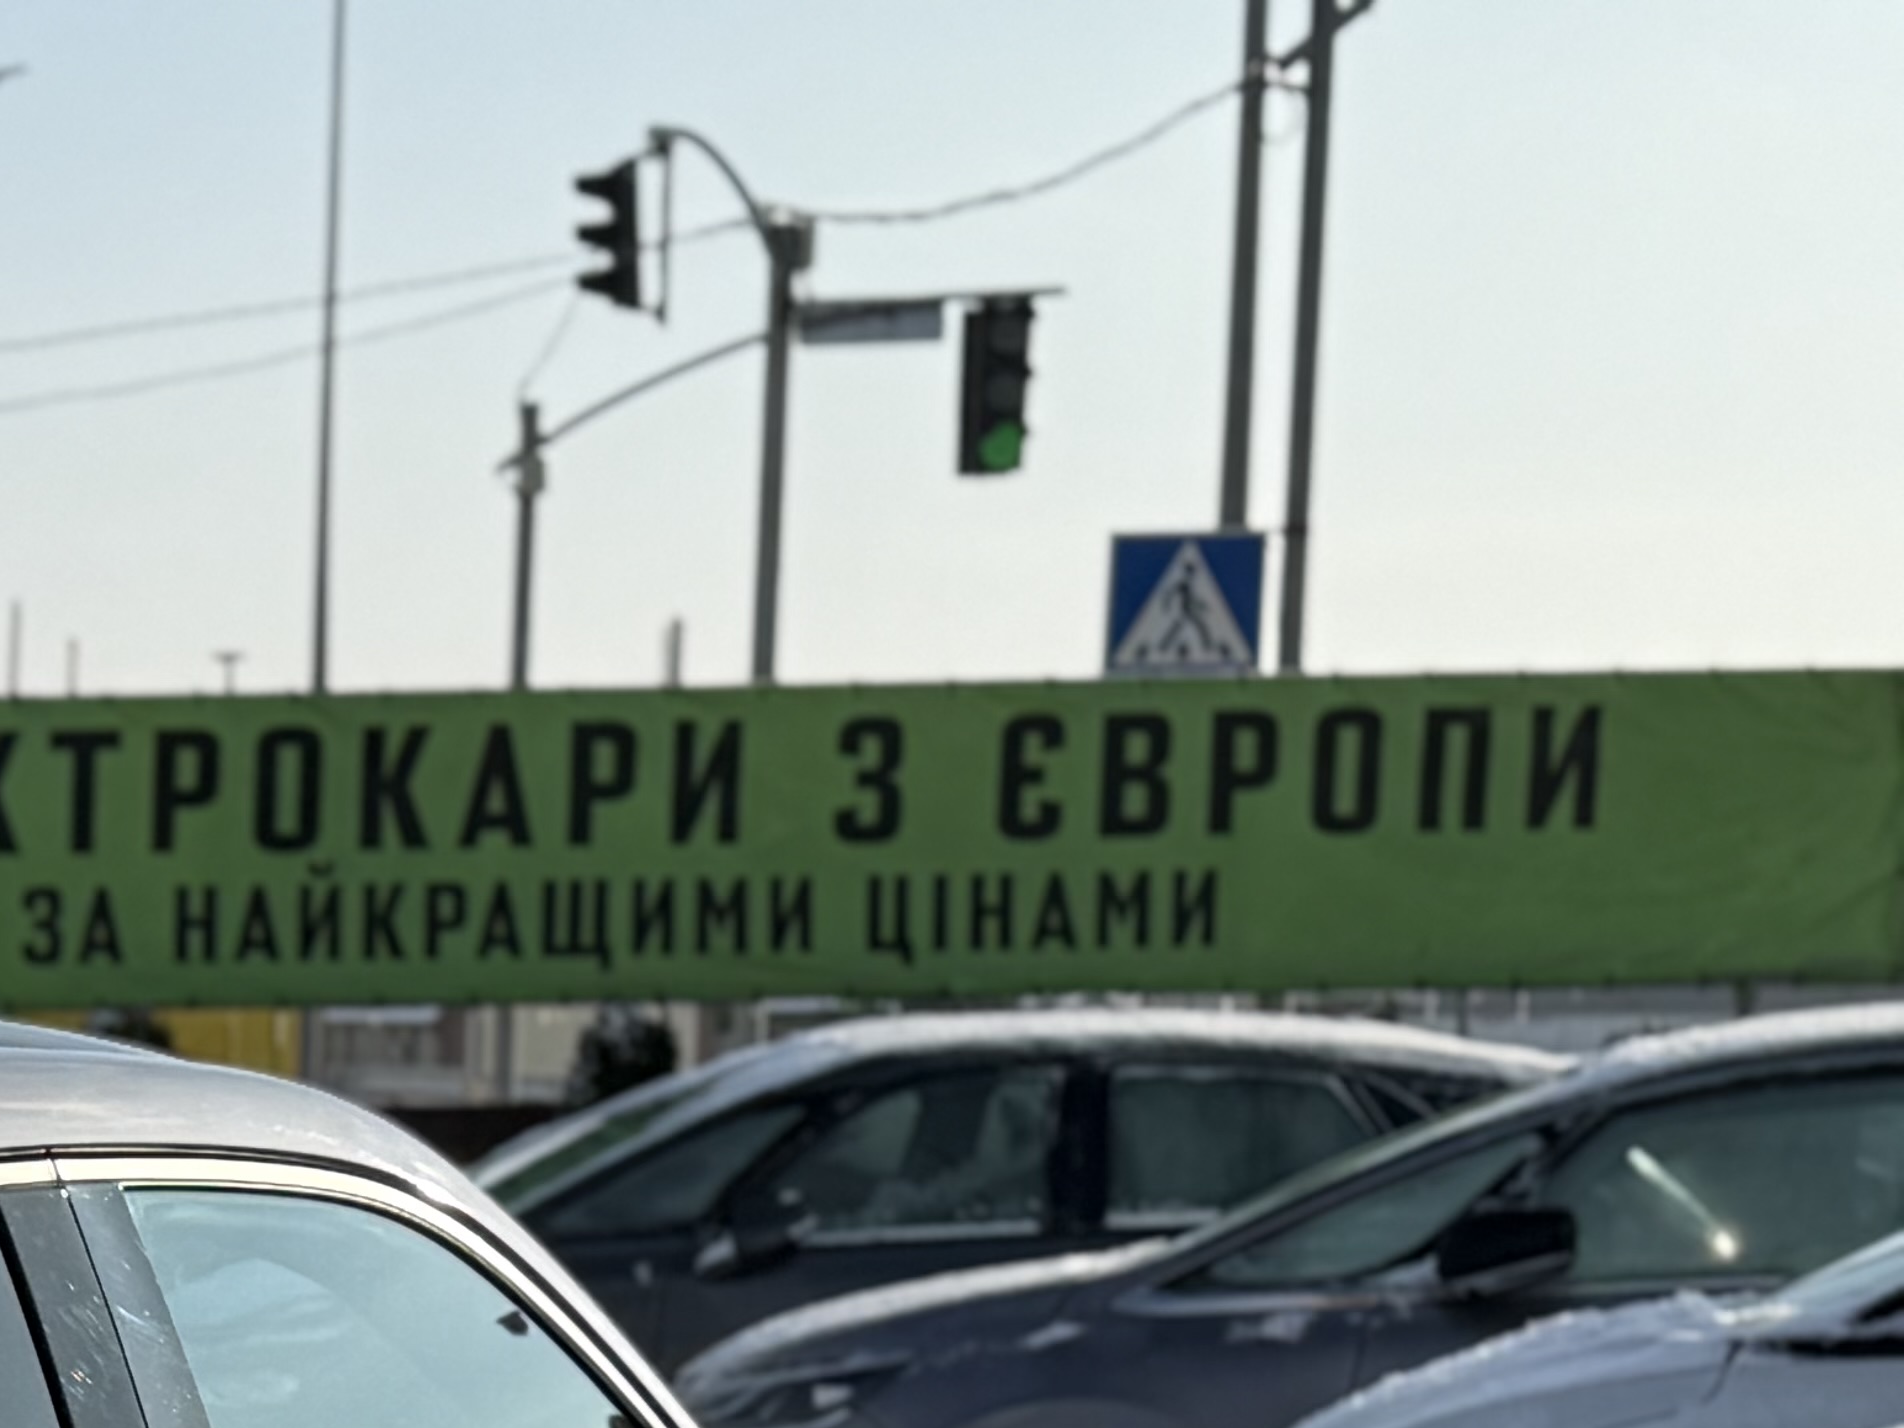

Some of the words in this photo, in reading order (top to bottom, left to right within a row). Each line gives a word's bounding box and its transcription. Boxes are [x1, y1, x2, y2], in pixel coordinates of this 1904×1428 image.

[830, 714, 906, 847] З
[994, 702, 1605, 844] ЄВРОПИ
[19, 884, 127, 968] ЗА
[171, 863, 816, 977] НАЙКРАЩИМИ
[863, 866, 1221, 971] ЦІНАМИ
